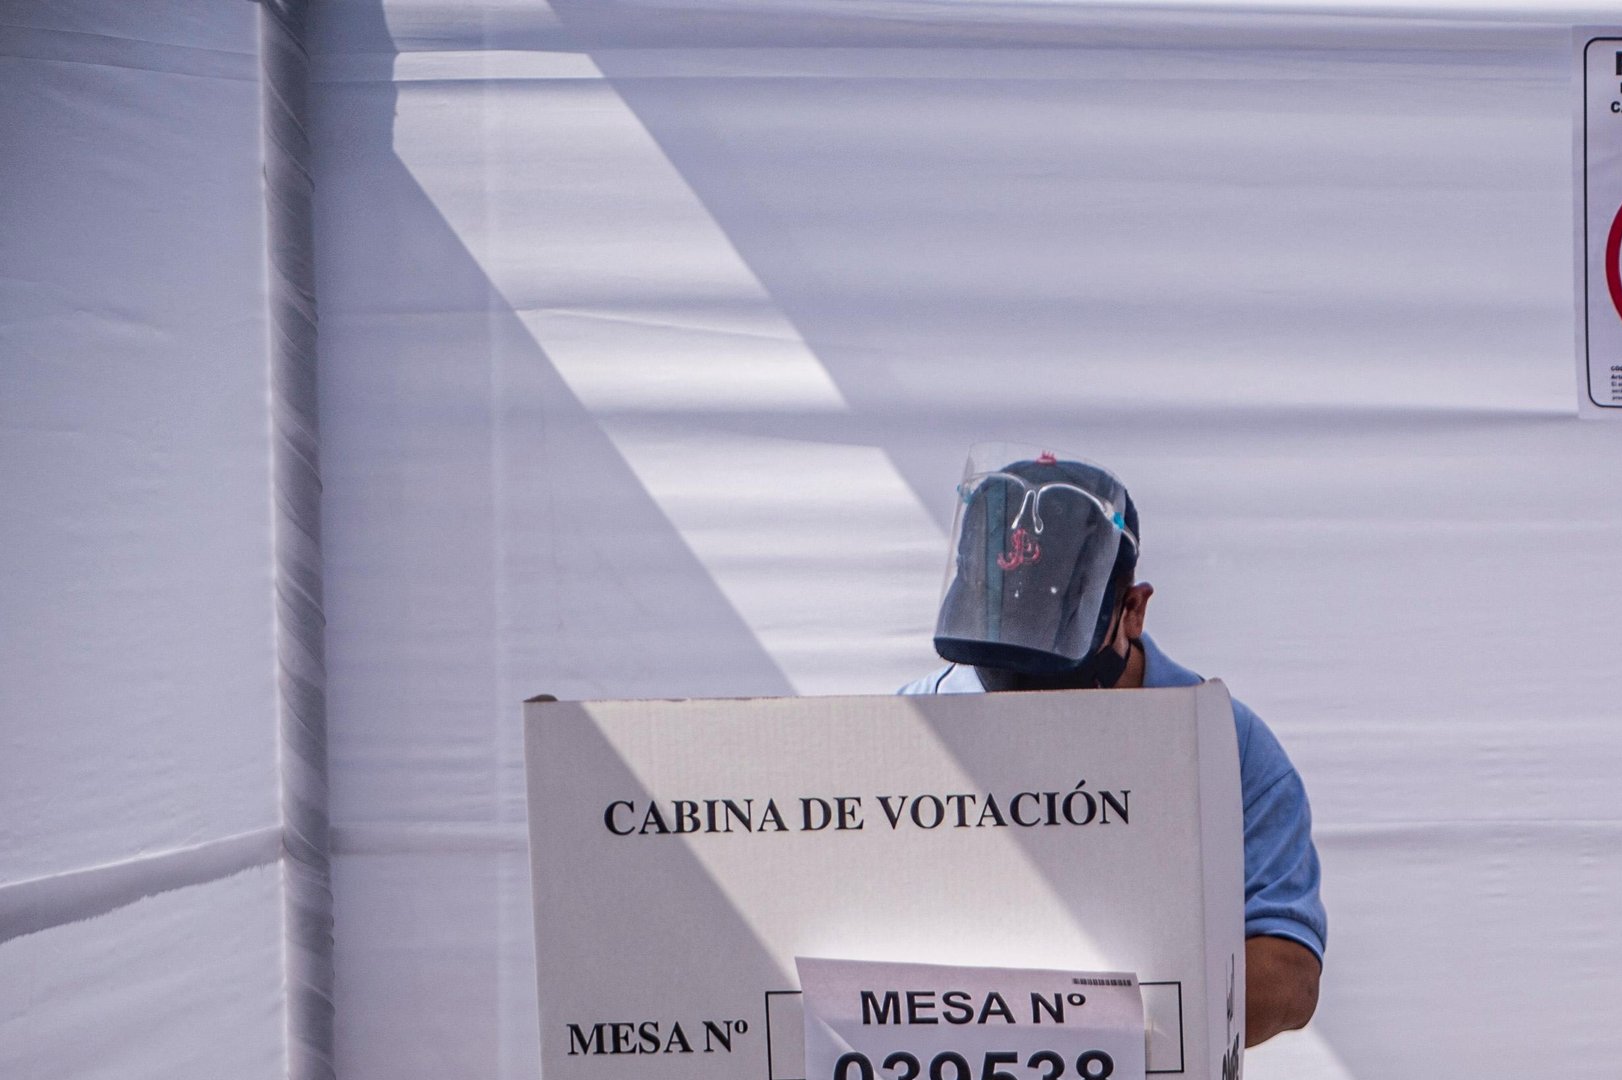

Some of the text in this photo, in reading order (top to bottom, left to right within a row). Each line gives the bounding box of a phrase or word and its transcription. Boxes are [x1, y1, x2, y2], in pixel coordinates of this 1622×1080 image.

[603, 779, 1132, 835] CABINA DE VOTACIÓN
[860, 990, 1087, 1026] MESA Nº
[566, 1019, 749, 1056] MESA Nº
